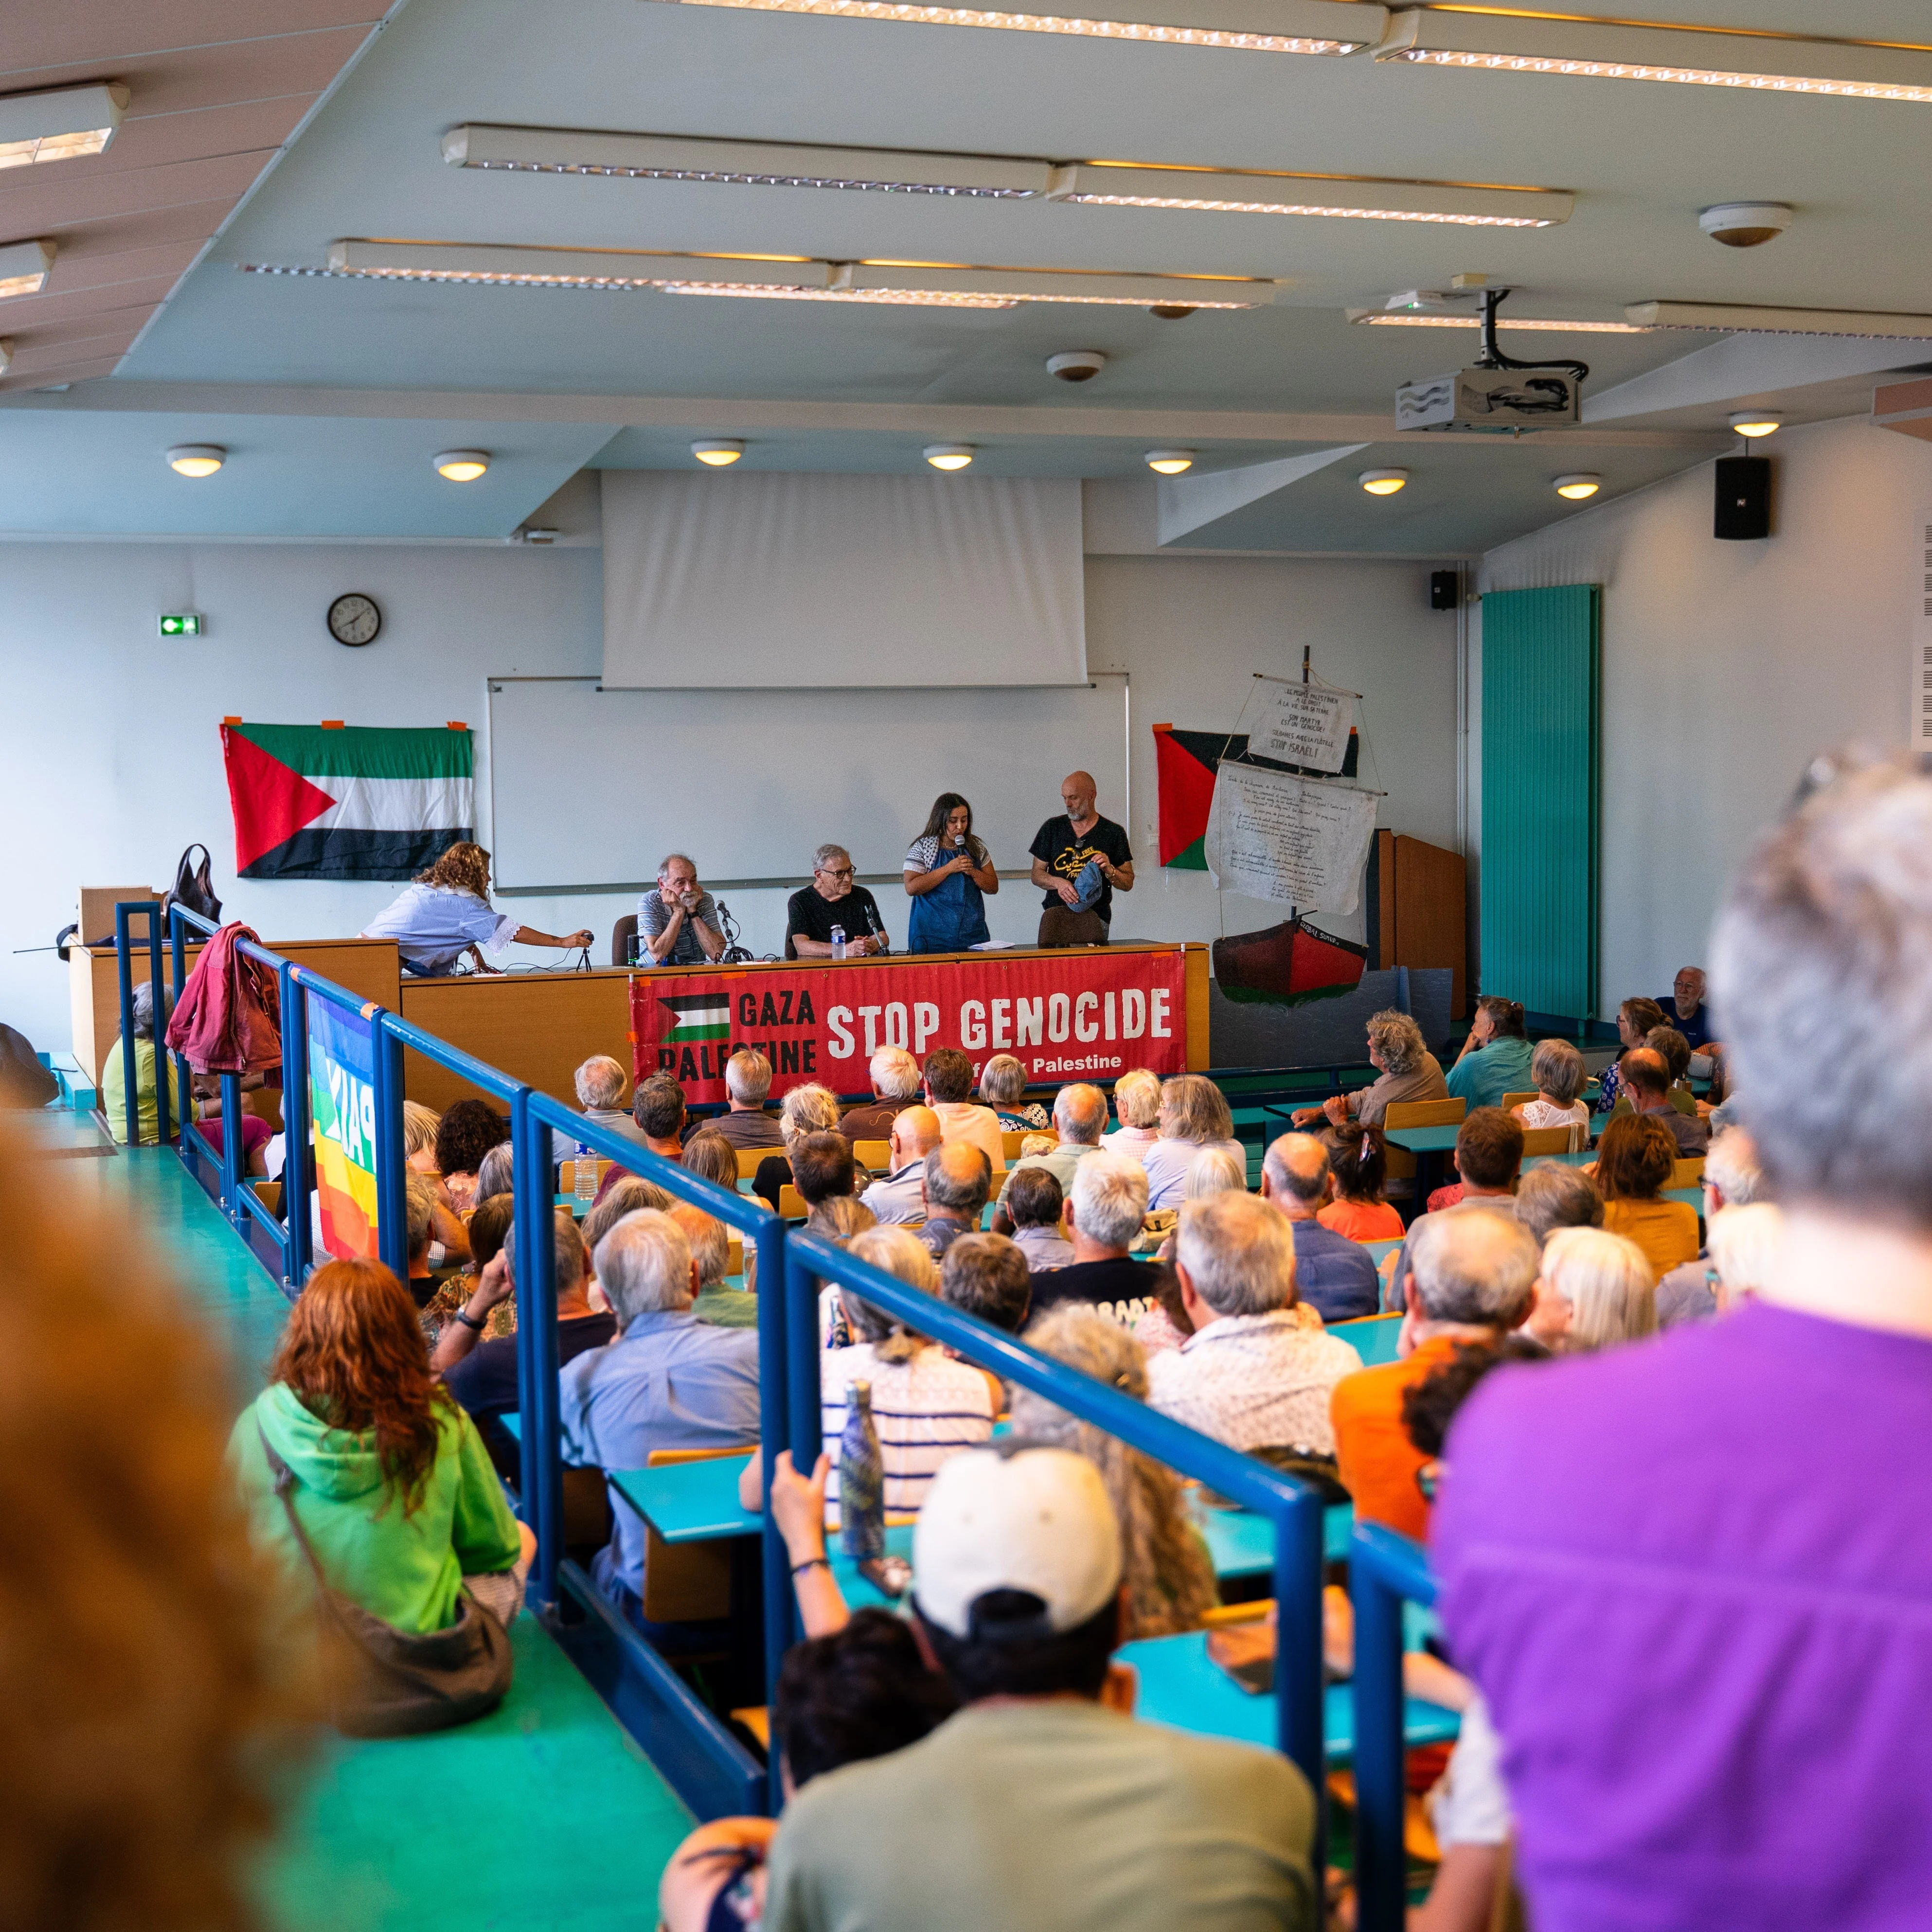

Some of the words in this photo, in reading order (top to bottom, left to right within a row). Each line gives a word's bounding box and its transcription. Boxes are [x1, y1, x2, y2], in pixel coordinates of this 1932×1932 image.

[1300, 716, 1321, 725] MARTYR
[1270, 738, 1287, 750] STOP
[1082, 846, 1094, 856] FREE
[1300, 922, 1318, 937] GLOBAL
[739, 990, 816, 1026] GAZA
[827, 1002, 939, 1058] STOP
[960, 988, 1171, 1050] GENOCIDE
[1033, 1055, 1122, 1073] Palestine
